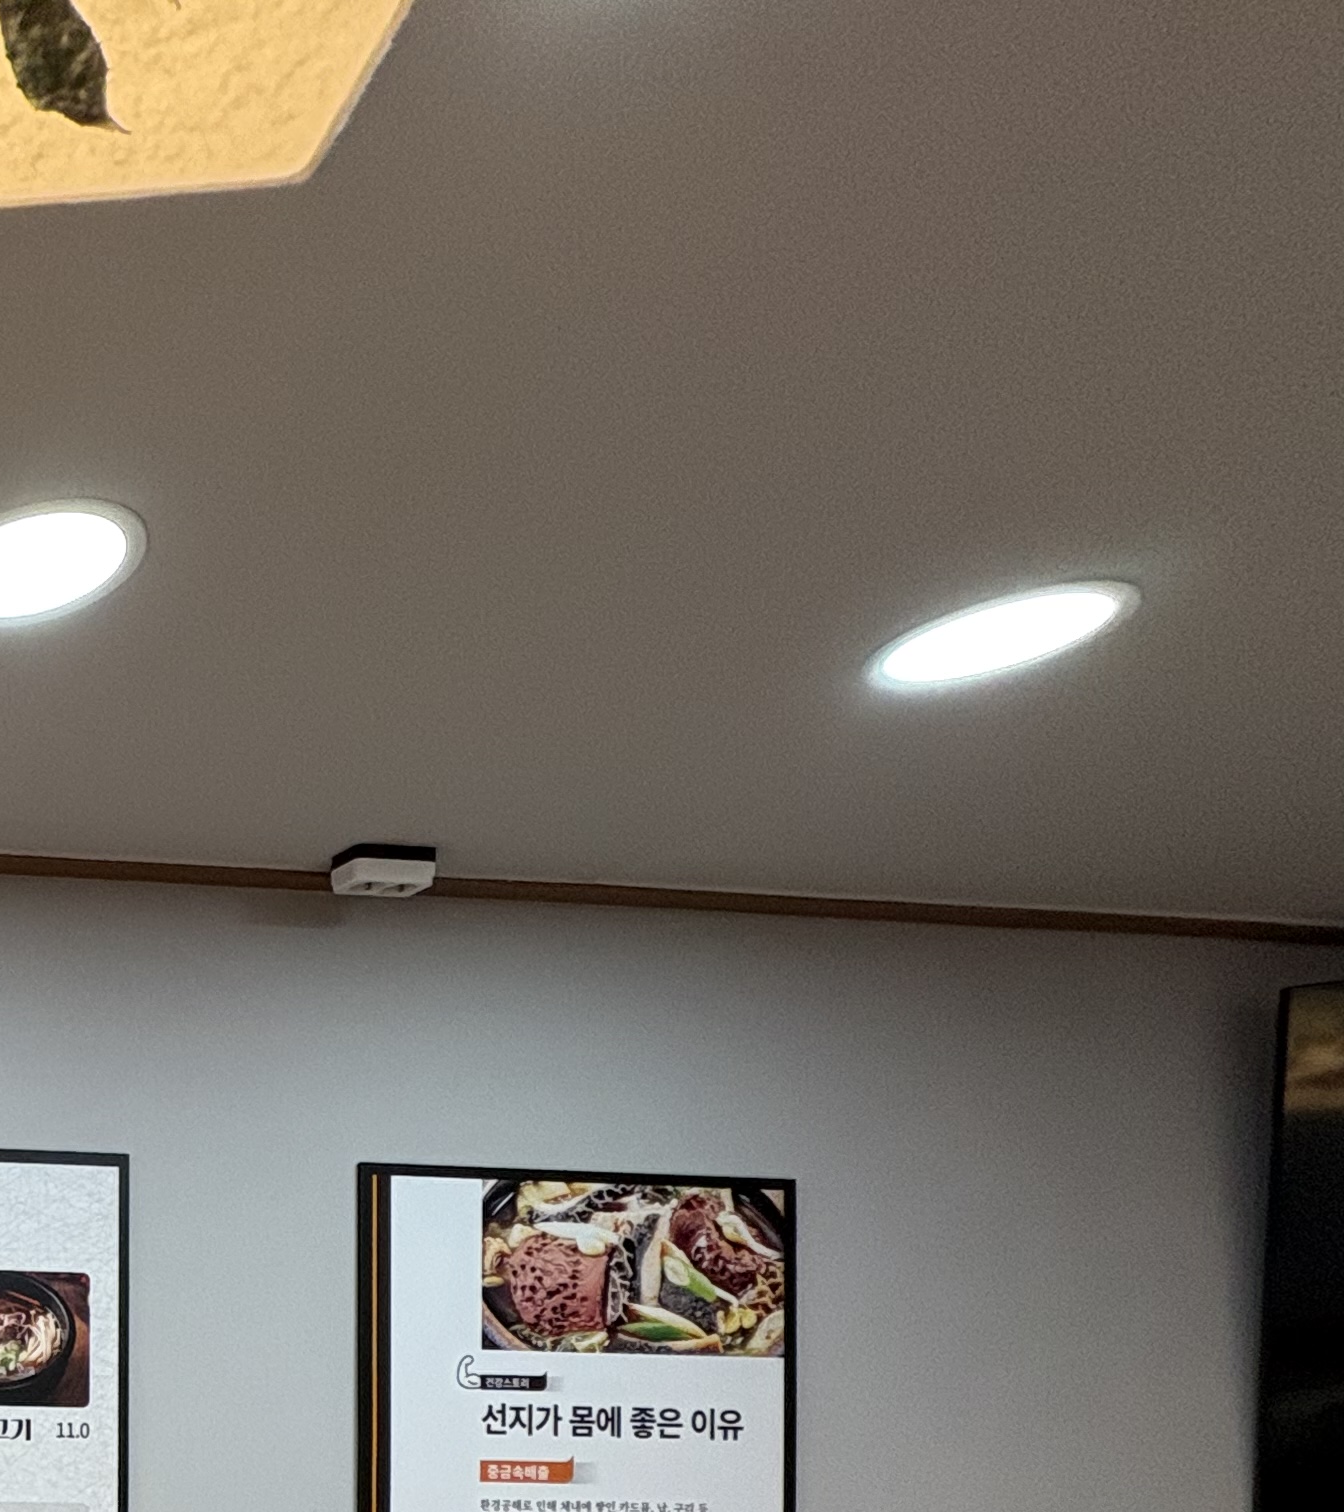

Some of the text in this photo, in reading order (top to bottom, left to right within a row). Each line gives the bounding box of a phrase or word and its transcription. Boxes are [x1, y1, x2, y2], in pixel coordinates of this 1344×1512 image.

[484, 1377, 531, 1390] 건강스토리
[481, 1402, 745, 1441] 선지가 몸에 좋은 이유
[55, 1422, 91, 1439] 11.0
[487, 1464, 550, 1481] 중금속배출
